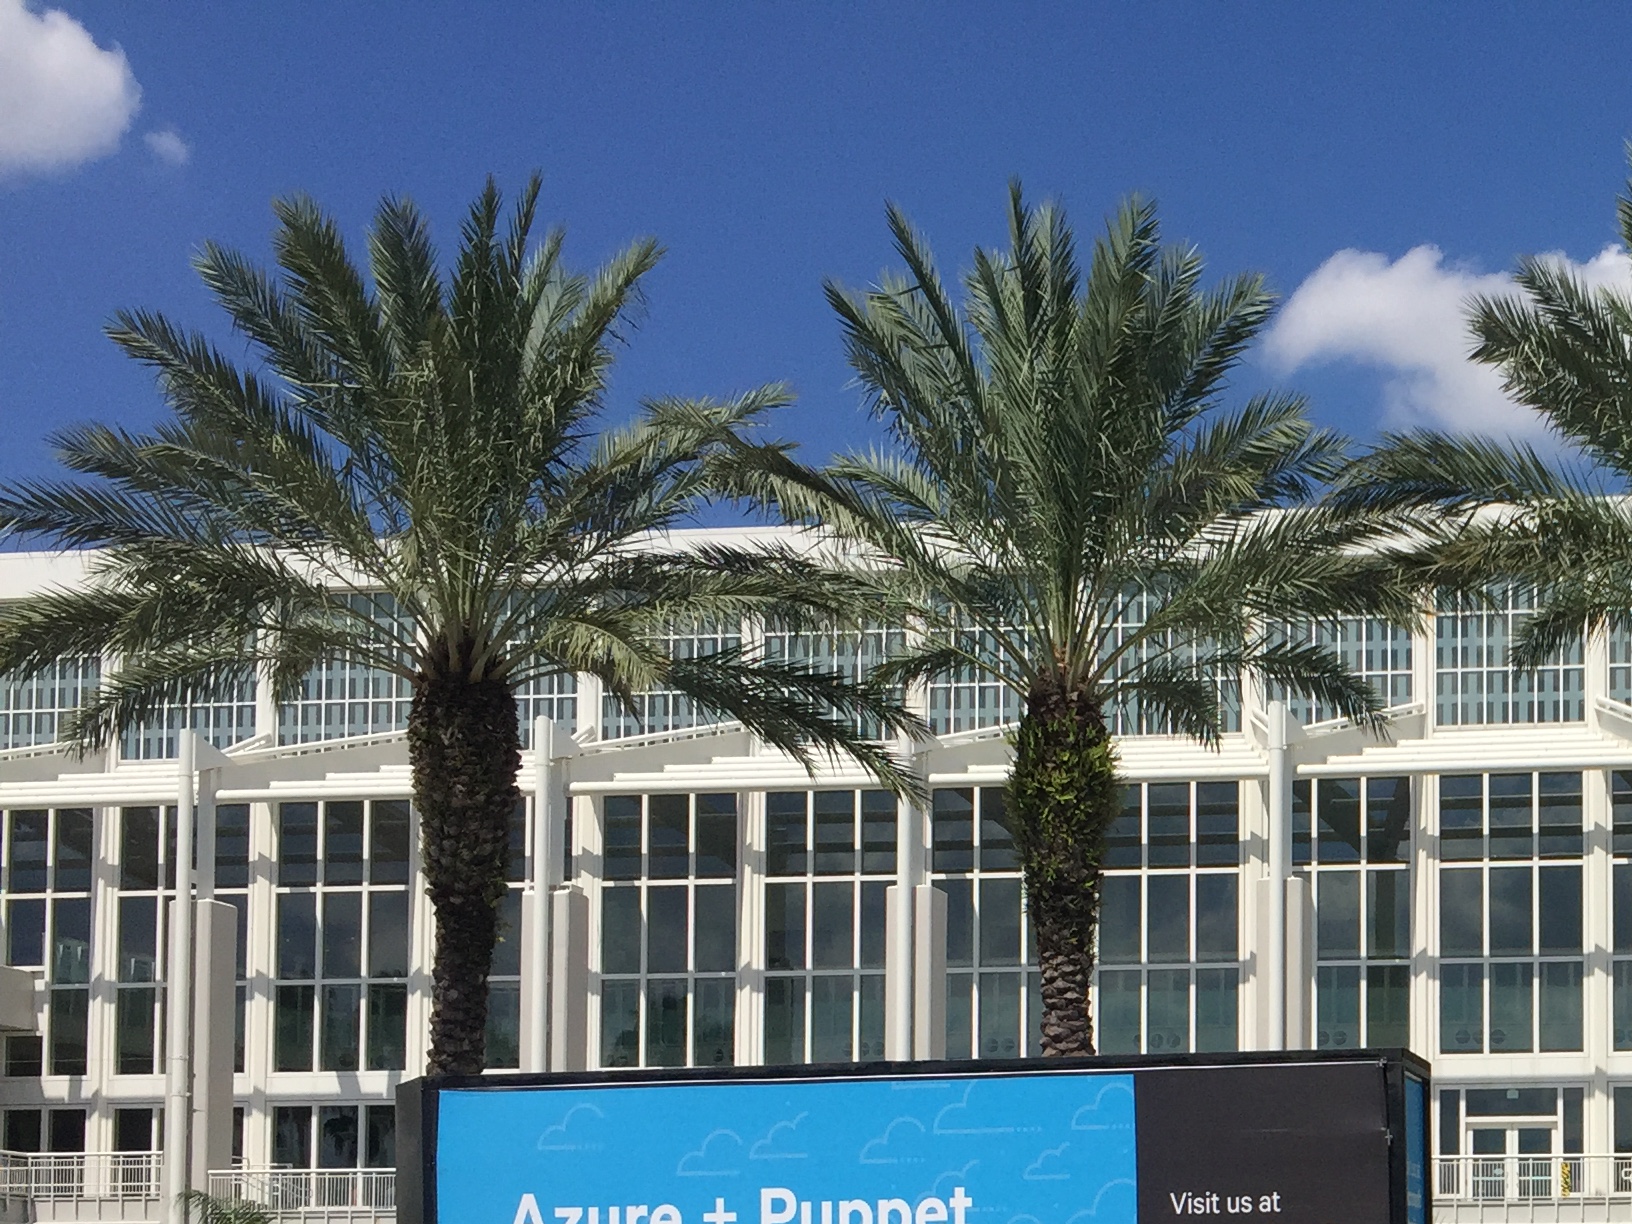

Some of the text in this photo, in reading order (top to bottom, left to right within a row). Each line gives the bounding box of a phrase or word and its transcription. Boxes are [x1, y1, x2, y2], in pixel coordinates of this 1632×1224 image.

[1169, 1191, 1282, 1215] Visit us at
